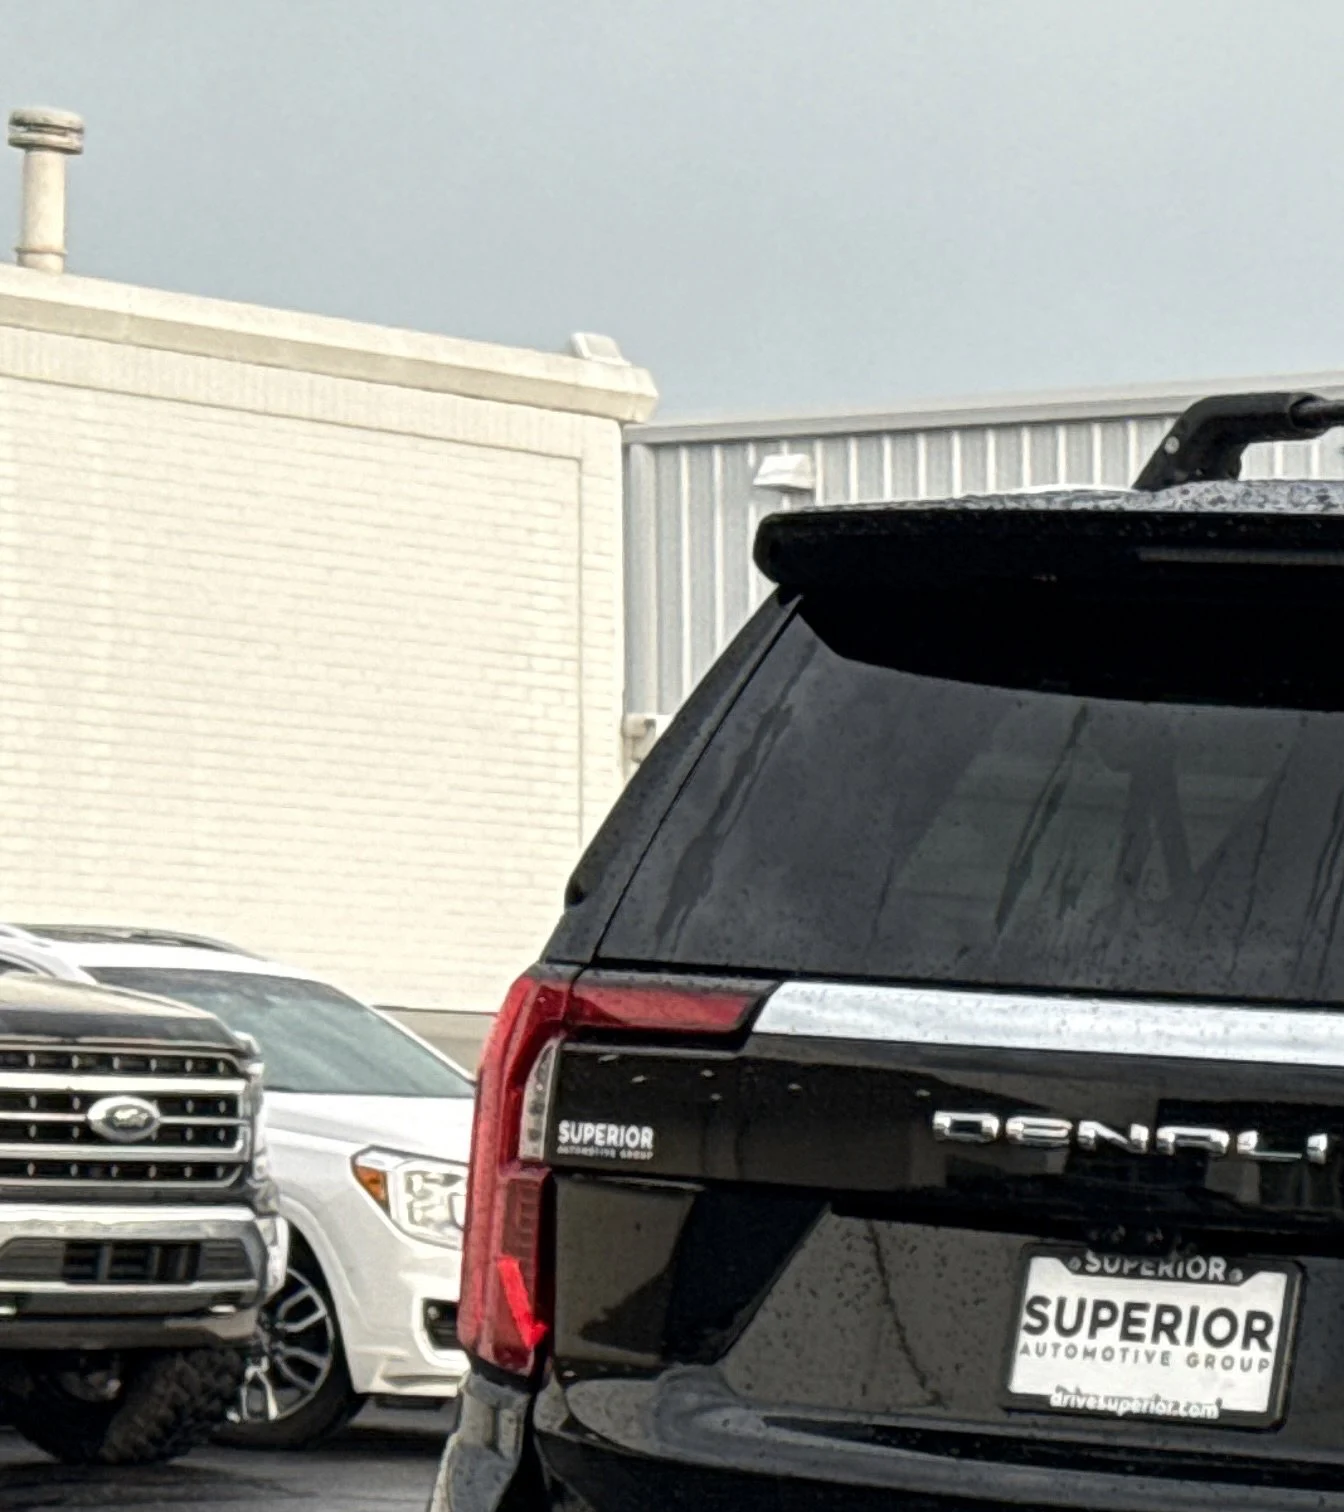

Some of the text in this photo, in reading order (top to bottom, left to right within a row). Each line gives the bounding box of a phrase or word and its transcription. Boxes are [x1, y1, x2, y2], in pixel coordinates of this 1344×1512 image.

[558, 1119, 654, 1149] SUPERIOR
[932, 1110, 1328, 1164] DENALI
[1023, 1295, 1274, 1352] SUPERIOR
[1019, 1341, 1271, 1373] AUTOMOTIVE GROUP
